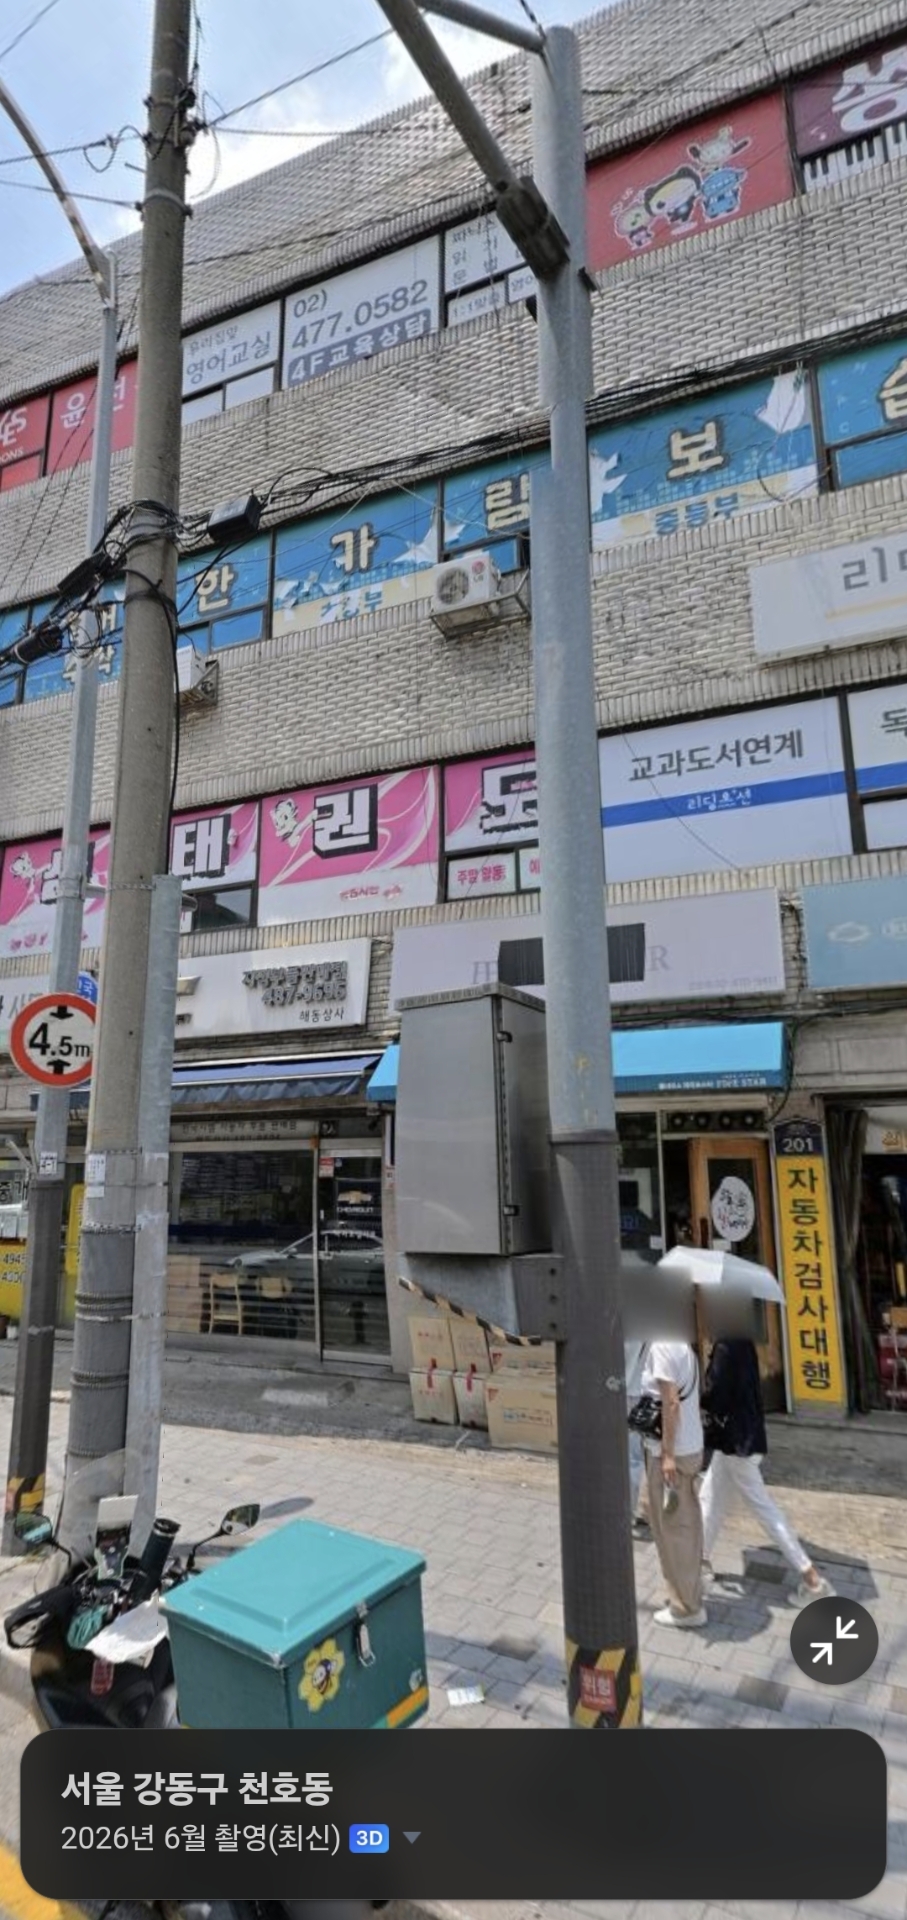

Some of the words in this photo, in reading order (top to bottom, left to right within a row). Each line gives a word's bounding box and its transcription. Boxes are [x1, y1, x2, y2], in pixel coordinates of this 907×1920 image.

[291, 279, 429, 350] 477.0582
[194, 564, 237, 612] 한
[330, 525, 377, 572] 가
[665, 420, 726, 479] 보
[628, 728, 804, 783] 교과도서연계
[313, 784, 377, 857] 권
[28, 1022, 91, 1058] 4.5m
[299, 1006, 345, 1023] 해동상사
[783, 1136, 815, 1153] 201
[787, 1166, 832, 1390] 자동차검사대행
